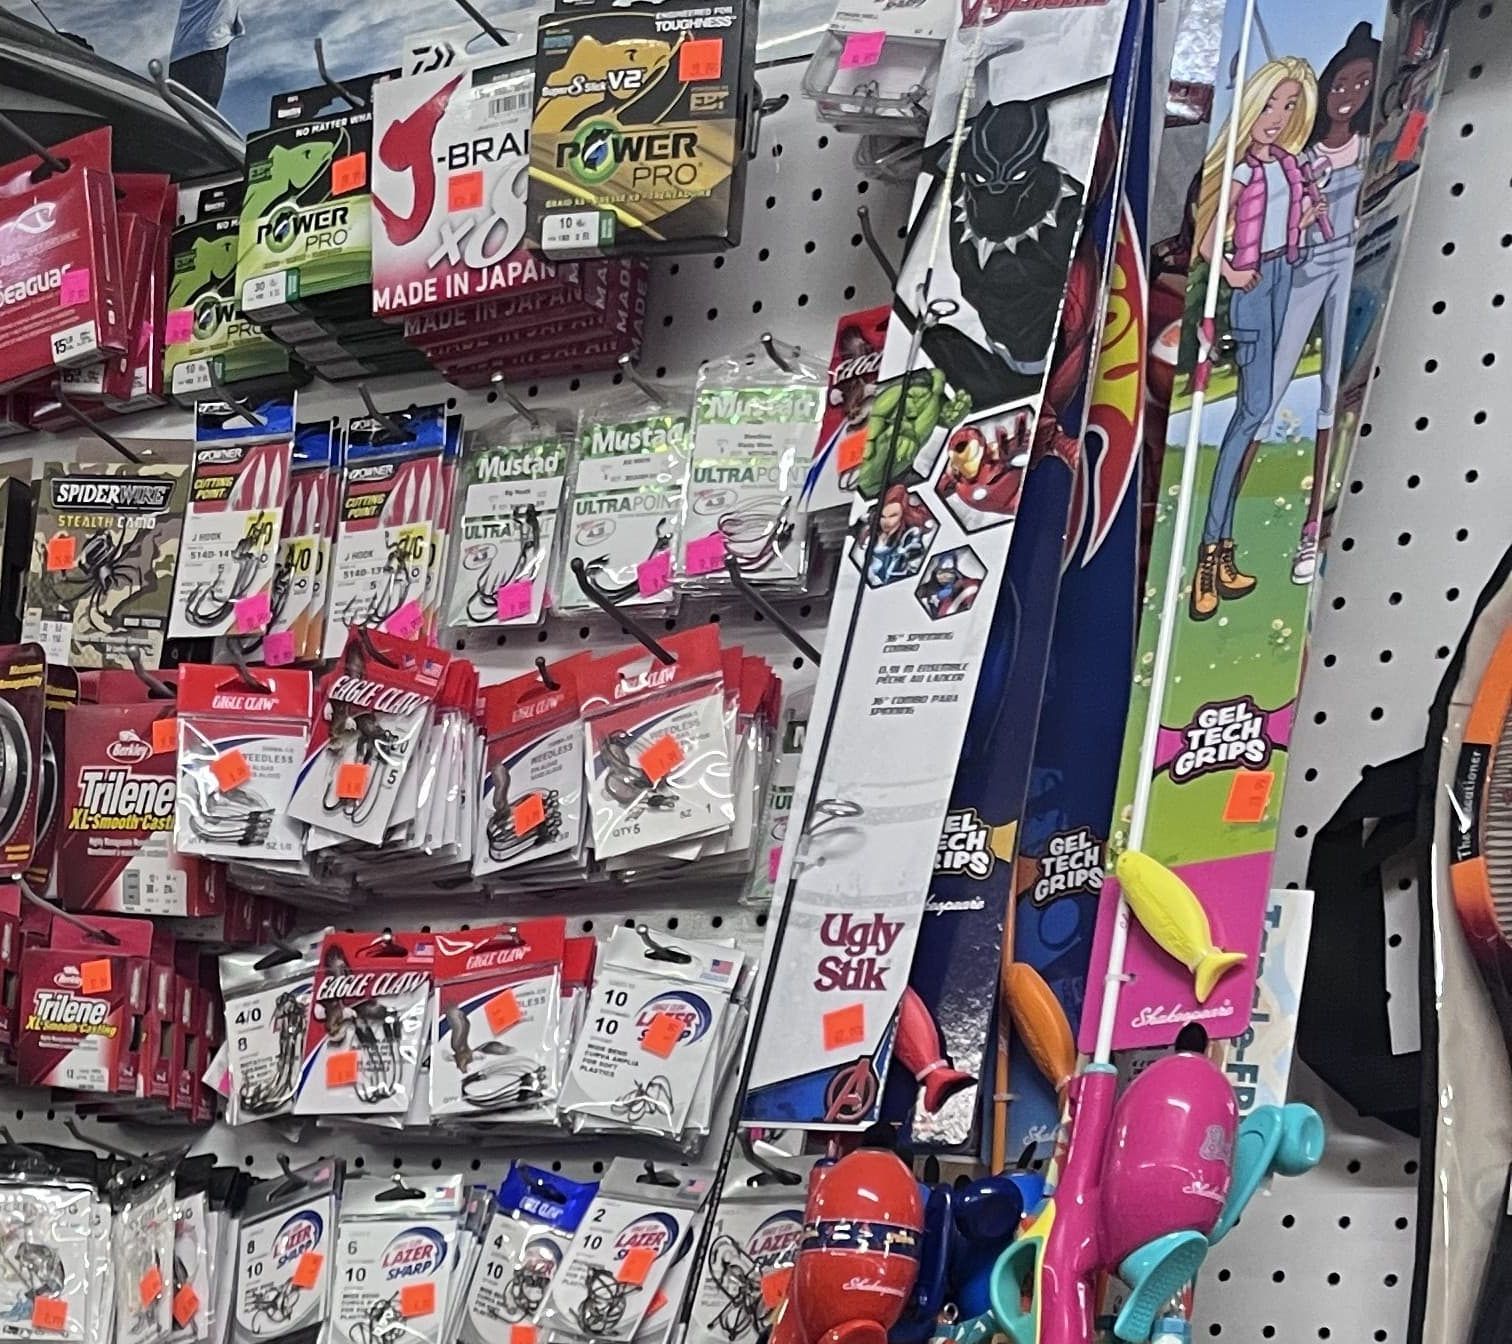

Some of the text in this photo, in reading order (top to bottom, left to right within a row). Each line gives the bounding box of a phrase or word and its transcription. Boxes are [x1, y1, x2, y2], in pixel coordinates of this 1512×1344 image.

[655, 7, 733, 20] ENGINEERED FOR
[607, 68, 643, 91] V2
[556, 120, 700, 177] POWER
[632, 162, 697, 187] PRO
[256, 202, 349, 249] POWER
[304, 230, 349, 249] PRO
[373, 261, 558, 312] MADE IN JAPAN
[54, 339, 67, 354] 15
[477, 452, 561, 479] Mustad
[57, 476, 170, 505] SPIDERWIRE
[192, 476, 234, 492] CUTTING
[195, 487, 228, 501] POINT
[345, 492, 387, 510] CUTTING
[58, 511, 157, 529] STEALTH CAMO
[328, 674, 432, 717] EAGLE CLAW
[1198, 703, 1253, 730] GEL
[1187, 720, 1263, 751] TECH
[1175, 739, 1267, 777] GRIPS
[946, 814, 978, 833] EL
[937, 832, 986, 853] ECH
[1049, 835, 1092, 855] GEL
[1042, 849, 1099, 874] TECH
[1034, 862, 1106, 899] GRIPS
[820, 912, 905, 957] Ugly
[813, 956, 888, 993] Stik
[316, 970, 430, 1001] EAGLE CLAW
[603, 990, 628, 1007] 10
[234, 1008, 262, 1026] 4/0
[594, 1017, 619, 1034] 10
[1131, 999, 1236, 1031] Shakespeare
[237, 1037, 247, 1052] 8
[593, 1208, 604, 1222] 2
[348, 1241, 358, 1255] 6
[493, 1234, 503, 1249] 4
[345, 1267, 366, 1282] 10
